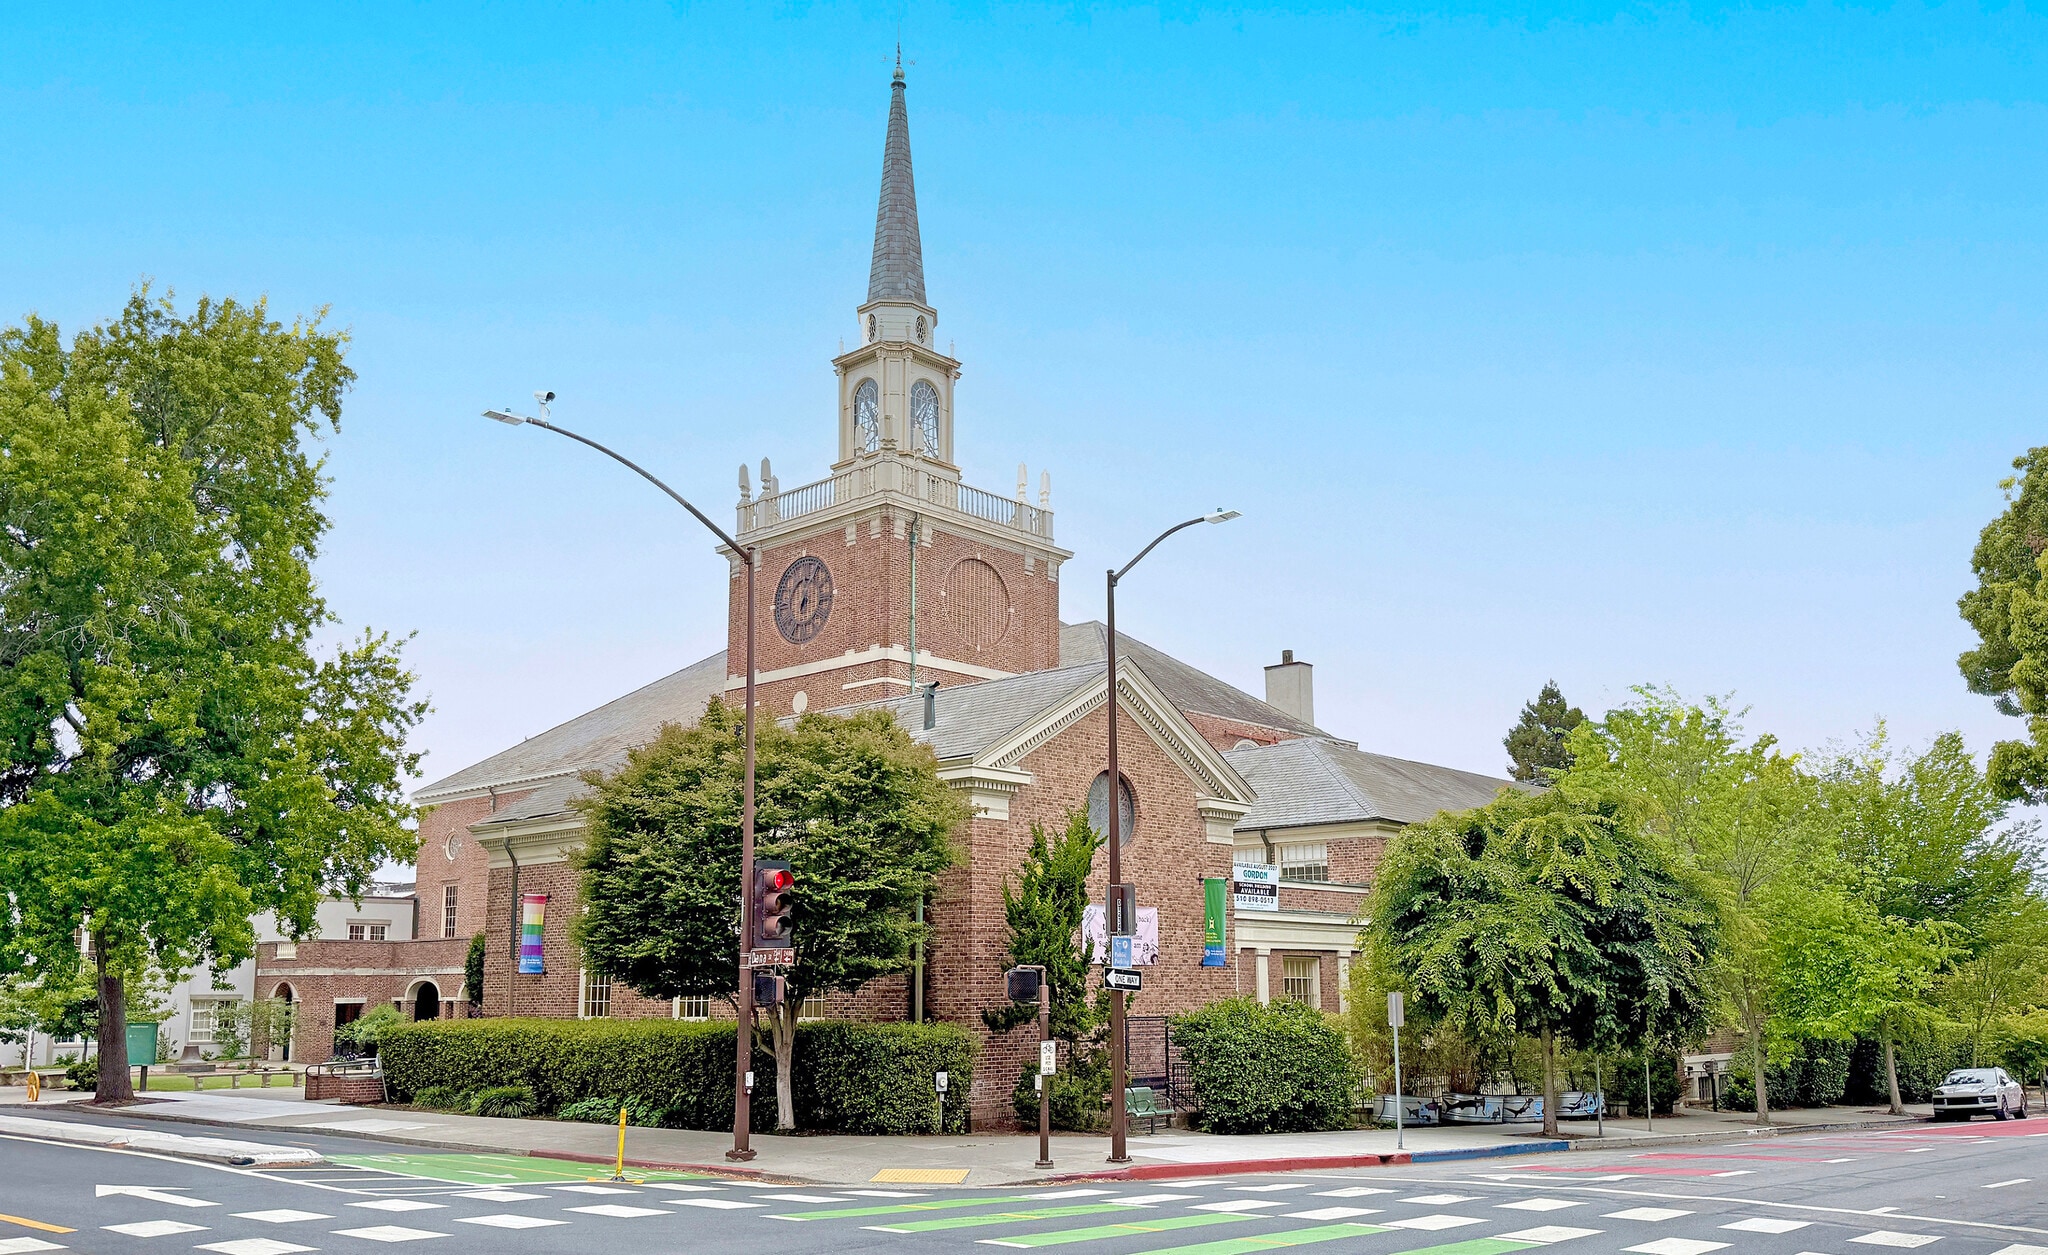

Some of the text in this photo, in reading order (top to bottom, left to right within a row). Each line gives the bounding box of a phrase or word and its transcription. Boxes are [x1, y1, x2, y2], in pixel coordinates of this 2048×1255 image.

[1243, 870, 1268, 879] GORDON
[1241, 888, 1270, 896] AVAILABLE
[752, 951, 767, 964] Dana
[1115, 974, 1138, 984] ONE WAY
